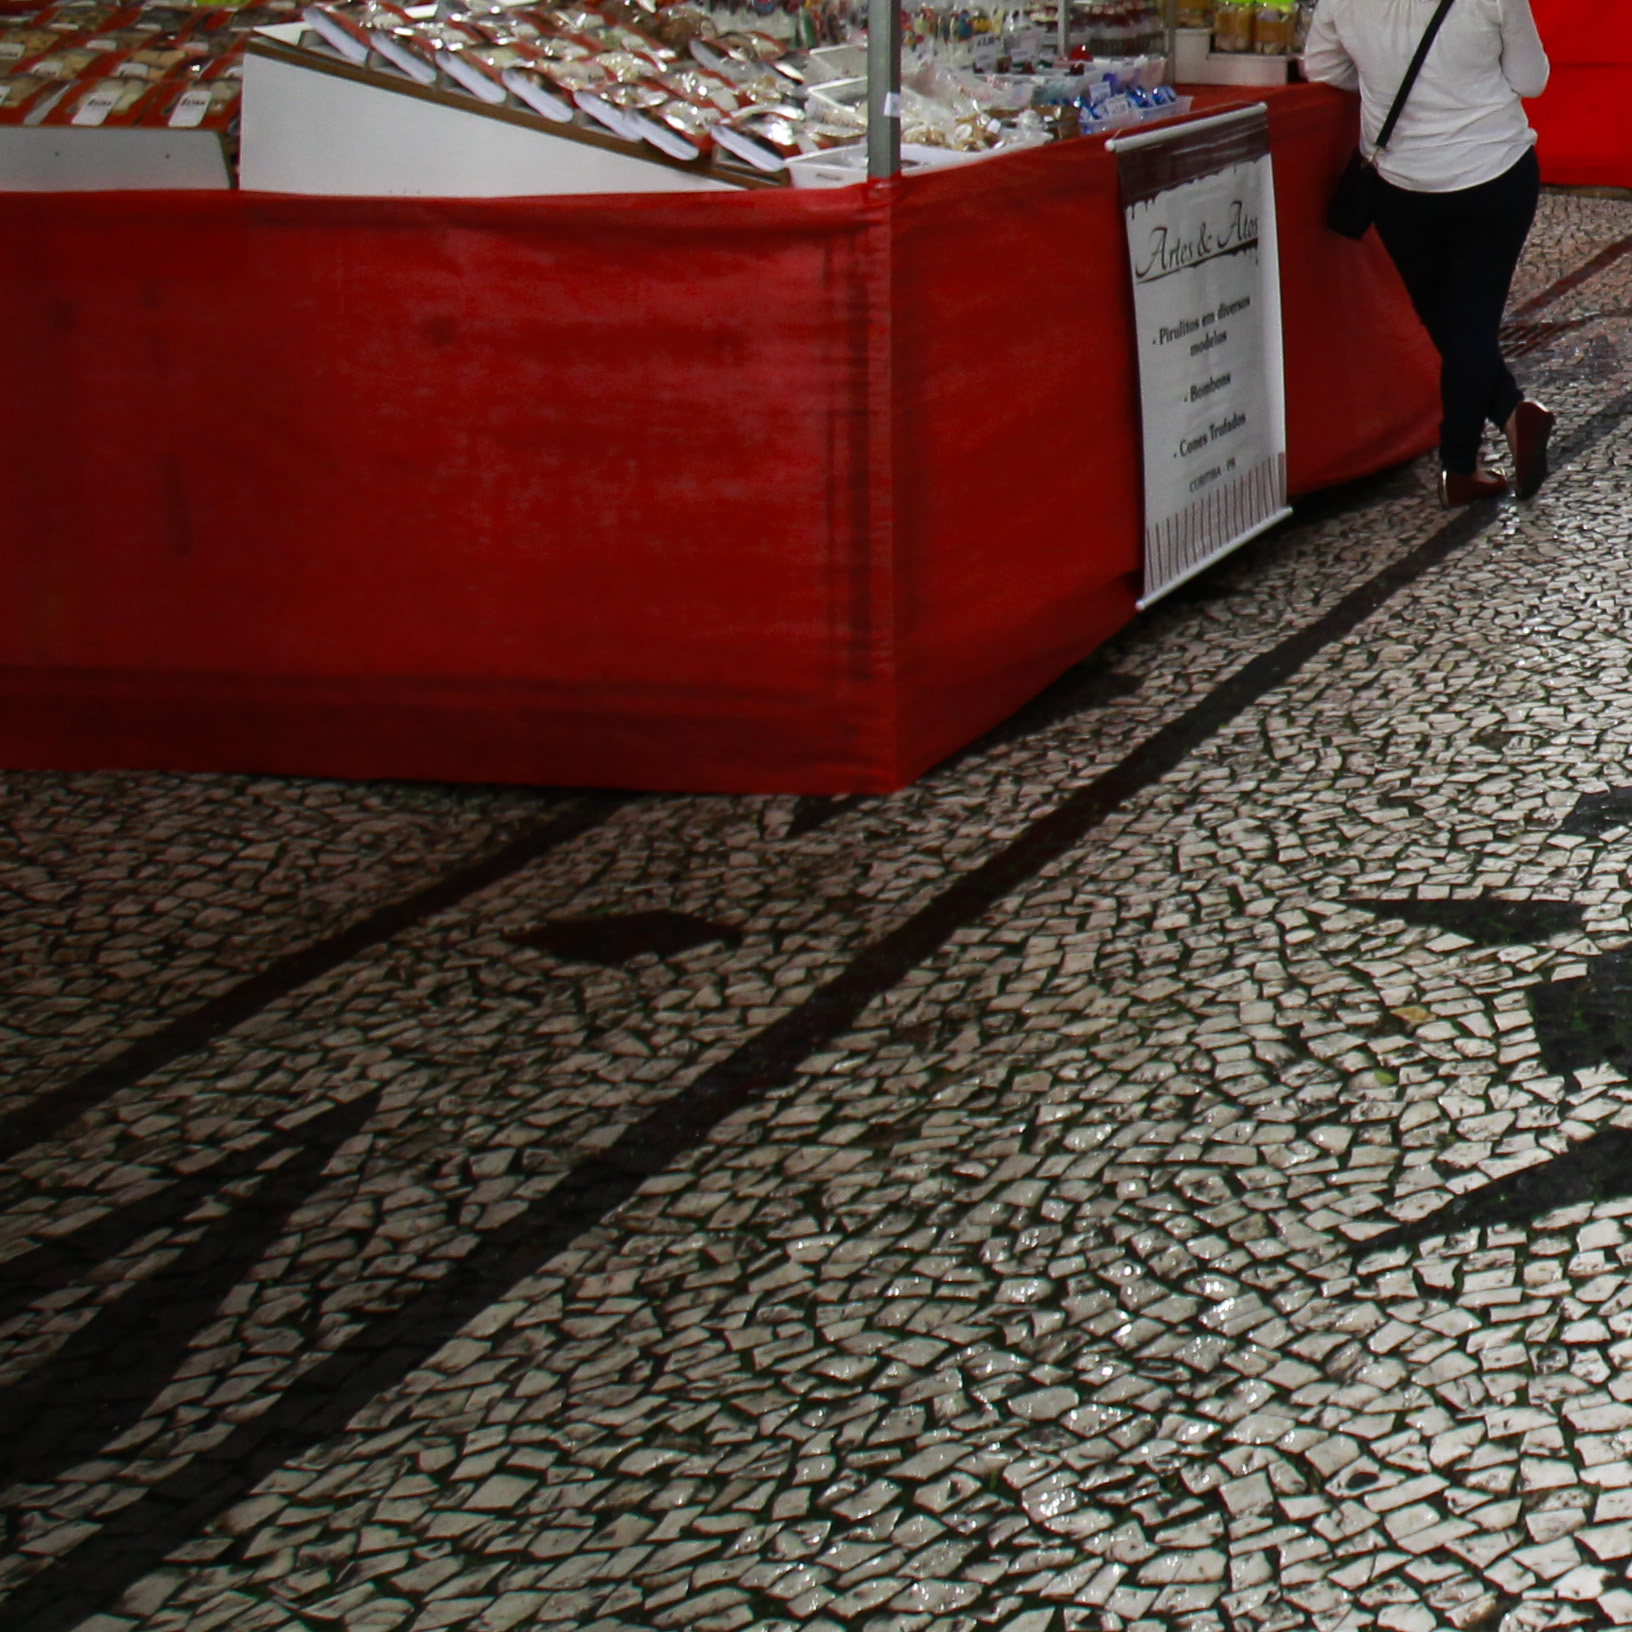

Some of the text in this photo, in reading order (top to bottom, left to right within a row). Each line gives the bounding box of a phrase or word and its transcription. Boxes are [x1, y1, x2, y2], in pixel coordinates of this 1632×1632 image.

[1135, 226, 1193, 279] Artes
[1217, 200, 1259, 249] Atos
[1159, 318, 1200, 346] Pirulitos
[1217, 295, 1251, 320] diversos
[1190, 329, 1227, 357] modelos
[1190, 372, 1231, 402] Bombons
[1179, 411, 1246, 457] Cones Trufados
